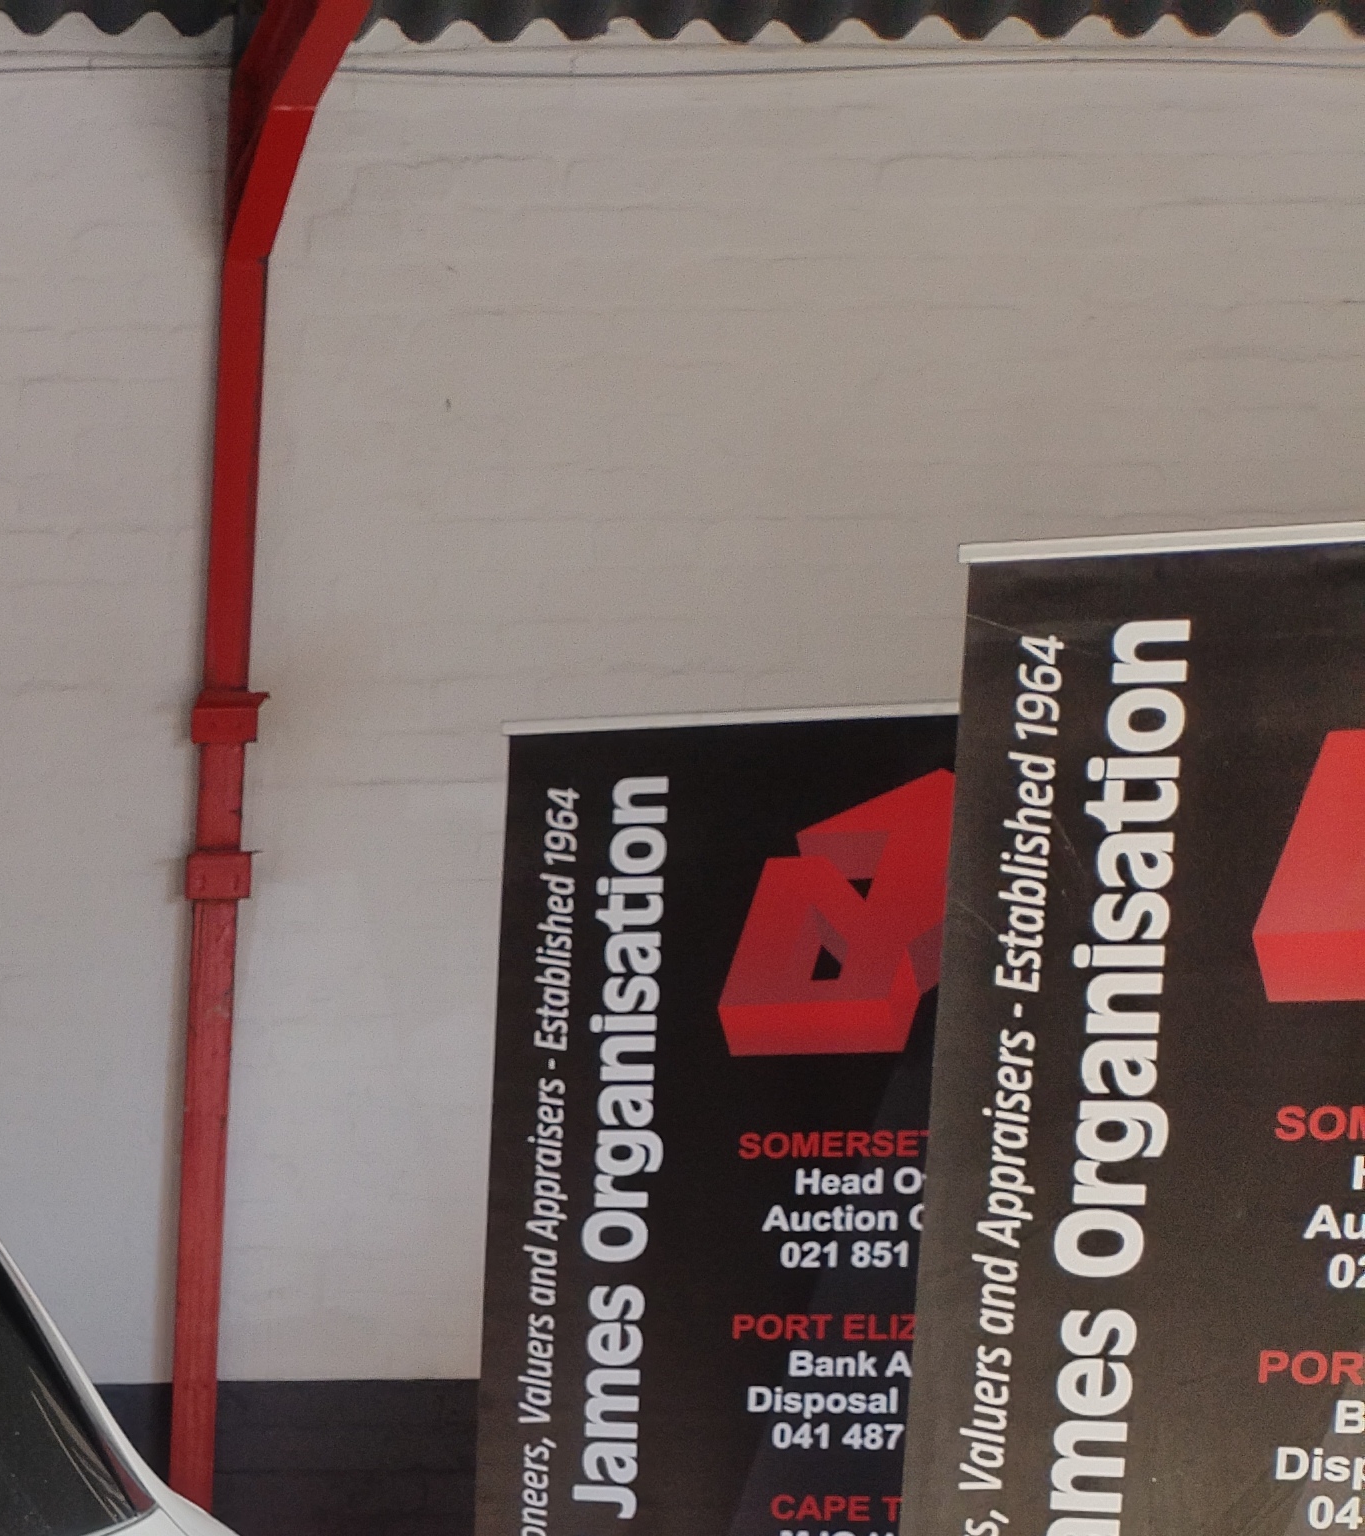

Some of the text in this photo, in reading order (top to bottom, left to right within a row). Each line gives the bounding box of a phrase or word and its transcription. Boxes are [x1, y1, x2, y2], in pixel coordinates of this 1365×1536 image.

[1015, 634, 1065, 741] 1964
[544, 786, 581, 866] 1964
[995, 751, 1056, 994] Established
[534, 874, 576, 1052] Established
[1054, 619, 1191, 1278] Organisation
[581, 775, 669, 1264] Organisation
[526, 1077, 568, 1241] Appraisers
[977, 1028, 1036, 1248] Appraisers
[762, 1204, 898, 1233] Auction
[795, 1168, 884, 1196] Head
[523, 1244, 558, 1307] and
[780, 1241, 910, 1269] 021 851
[972, 1254, 1019, 1335] and
[731, 1314, 833, 1340] PORT
[788, 1350, 877, 1378] Bank
[518, 1312, 557, 1424] Valuers
[572, 1284, 646, 1519] James
[747, 1386, 898, 1418] Disposal
[772, 1423, 905, 1451] 041 487
[959, 1345, 1012, 1491] Valuers
[770, 1495, 871, 1522] CAPE
